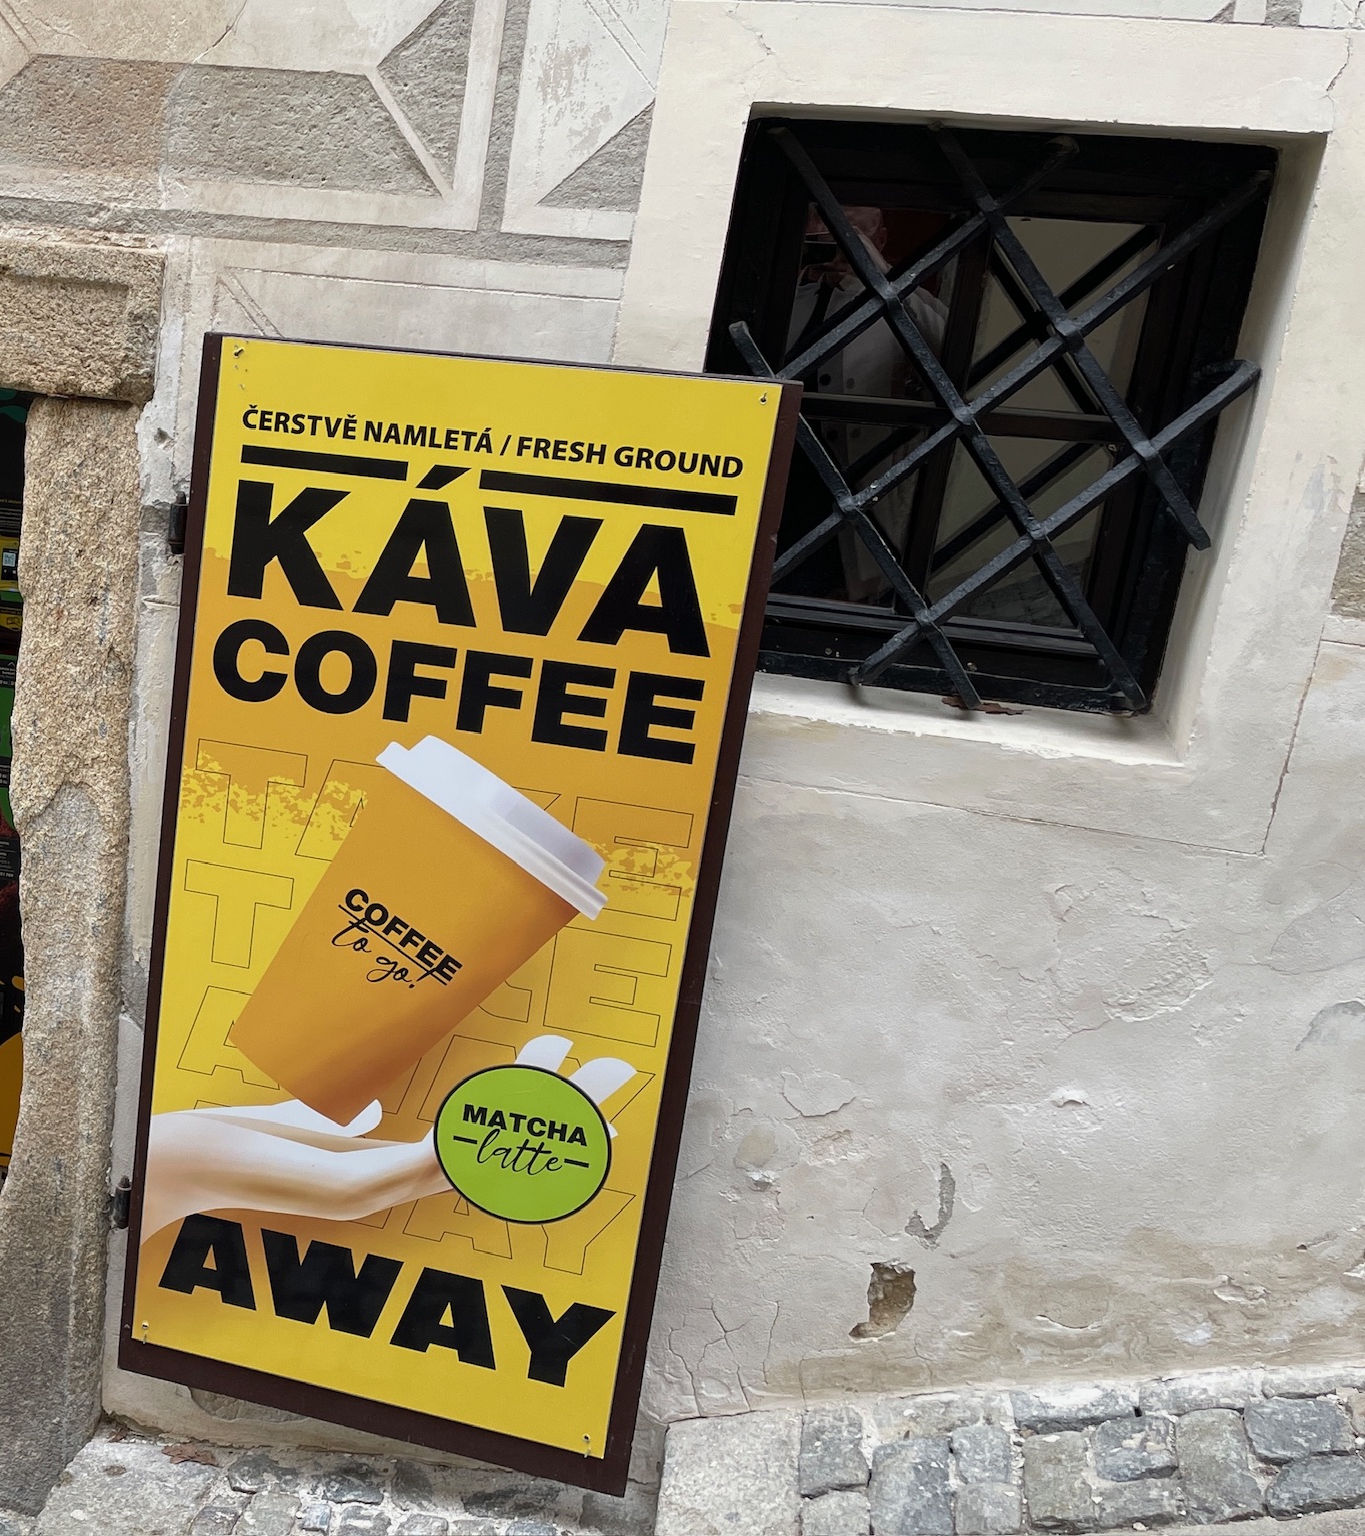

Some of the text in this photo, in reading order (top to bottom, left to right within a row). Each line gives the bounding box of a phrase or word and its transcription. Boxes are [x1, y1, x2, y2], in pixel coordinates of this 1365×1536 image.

[241, 404, 744, 479] ČERSTVĚ NAMLETÁ / FRESH GROUND
[227, 463, 712, 658] KÁVA
[211, 618, 707, 765] COFFEE
[331, 916, 373, 954] to
[344, 888, 464, 982] COFFEE
[462, 1103, 588, 1147] MATCHA
[476, 1128, 563, 1176] latte
[158, 1212, 617, 1388] AWAY
